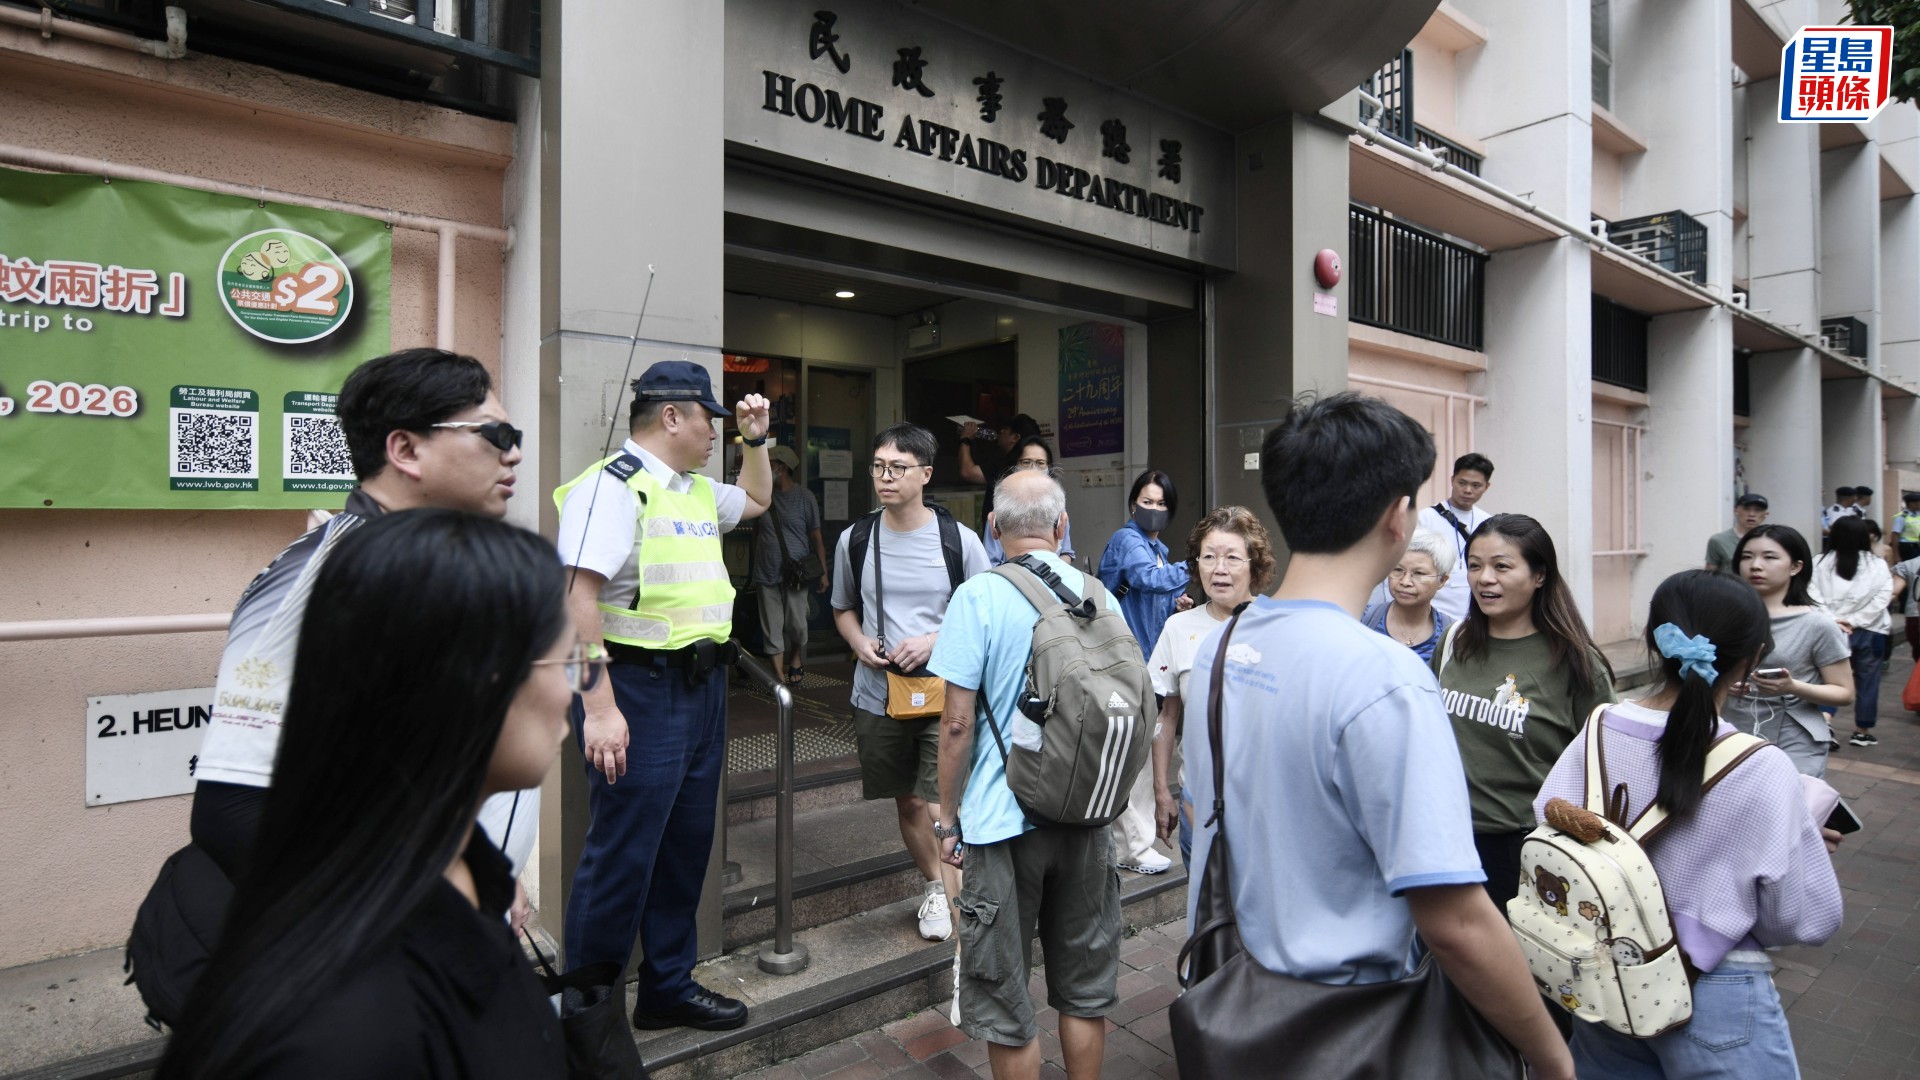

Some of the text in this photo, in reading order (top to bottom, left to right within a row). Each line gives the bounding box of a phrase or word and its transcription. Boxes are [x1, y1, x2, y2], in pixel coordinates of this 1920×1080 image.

[809, 10, 1183, 184] 民政事務總署
[762, 70, 1205, 233] HOME AFFAIRS DEPARTMENT
[230, 288, 271, 302] 公共交通
[275, 264, 335, 312] $2
[63, 313, 93, 331] to
[30, 383, 134, 414] 2026
[178, 387, 252, 399] 勞工及福利局網頁
[176, 480, 253, 490] www.lwb.gov.hk
[292, 482, 354, 491] www.td.gov.hk
[97, 714, 127, 738] 2.
